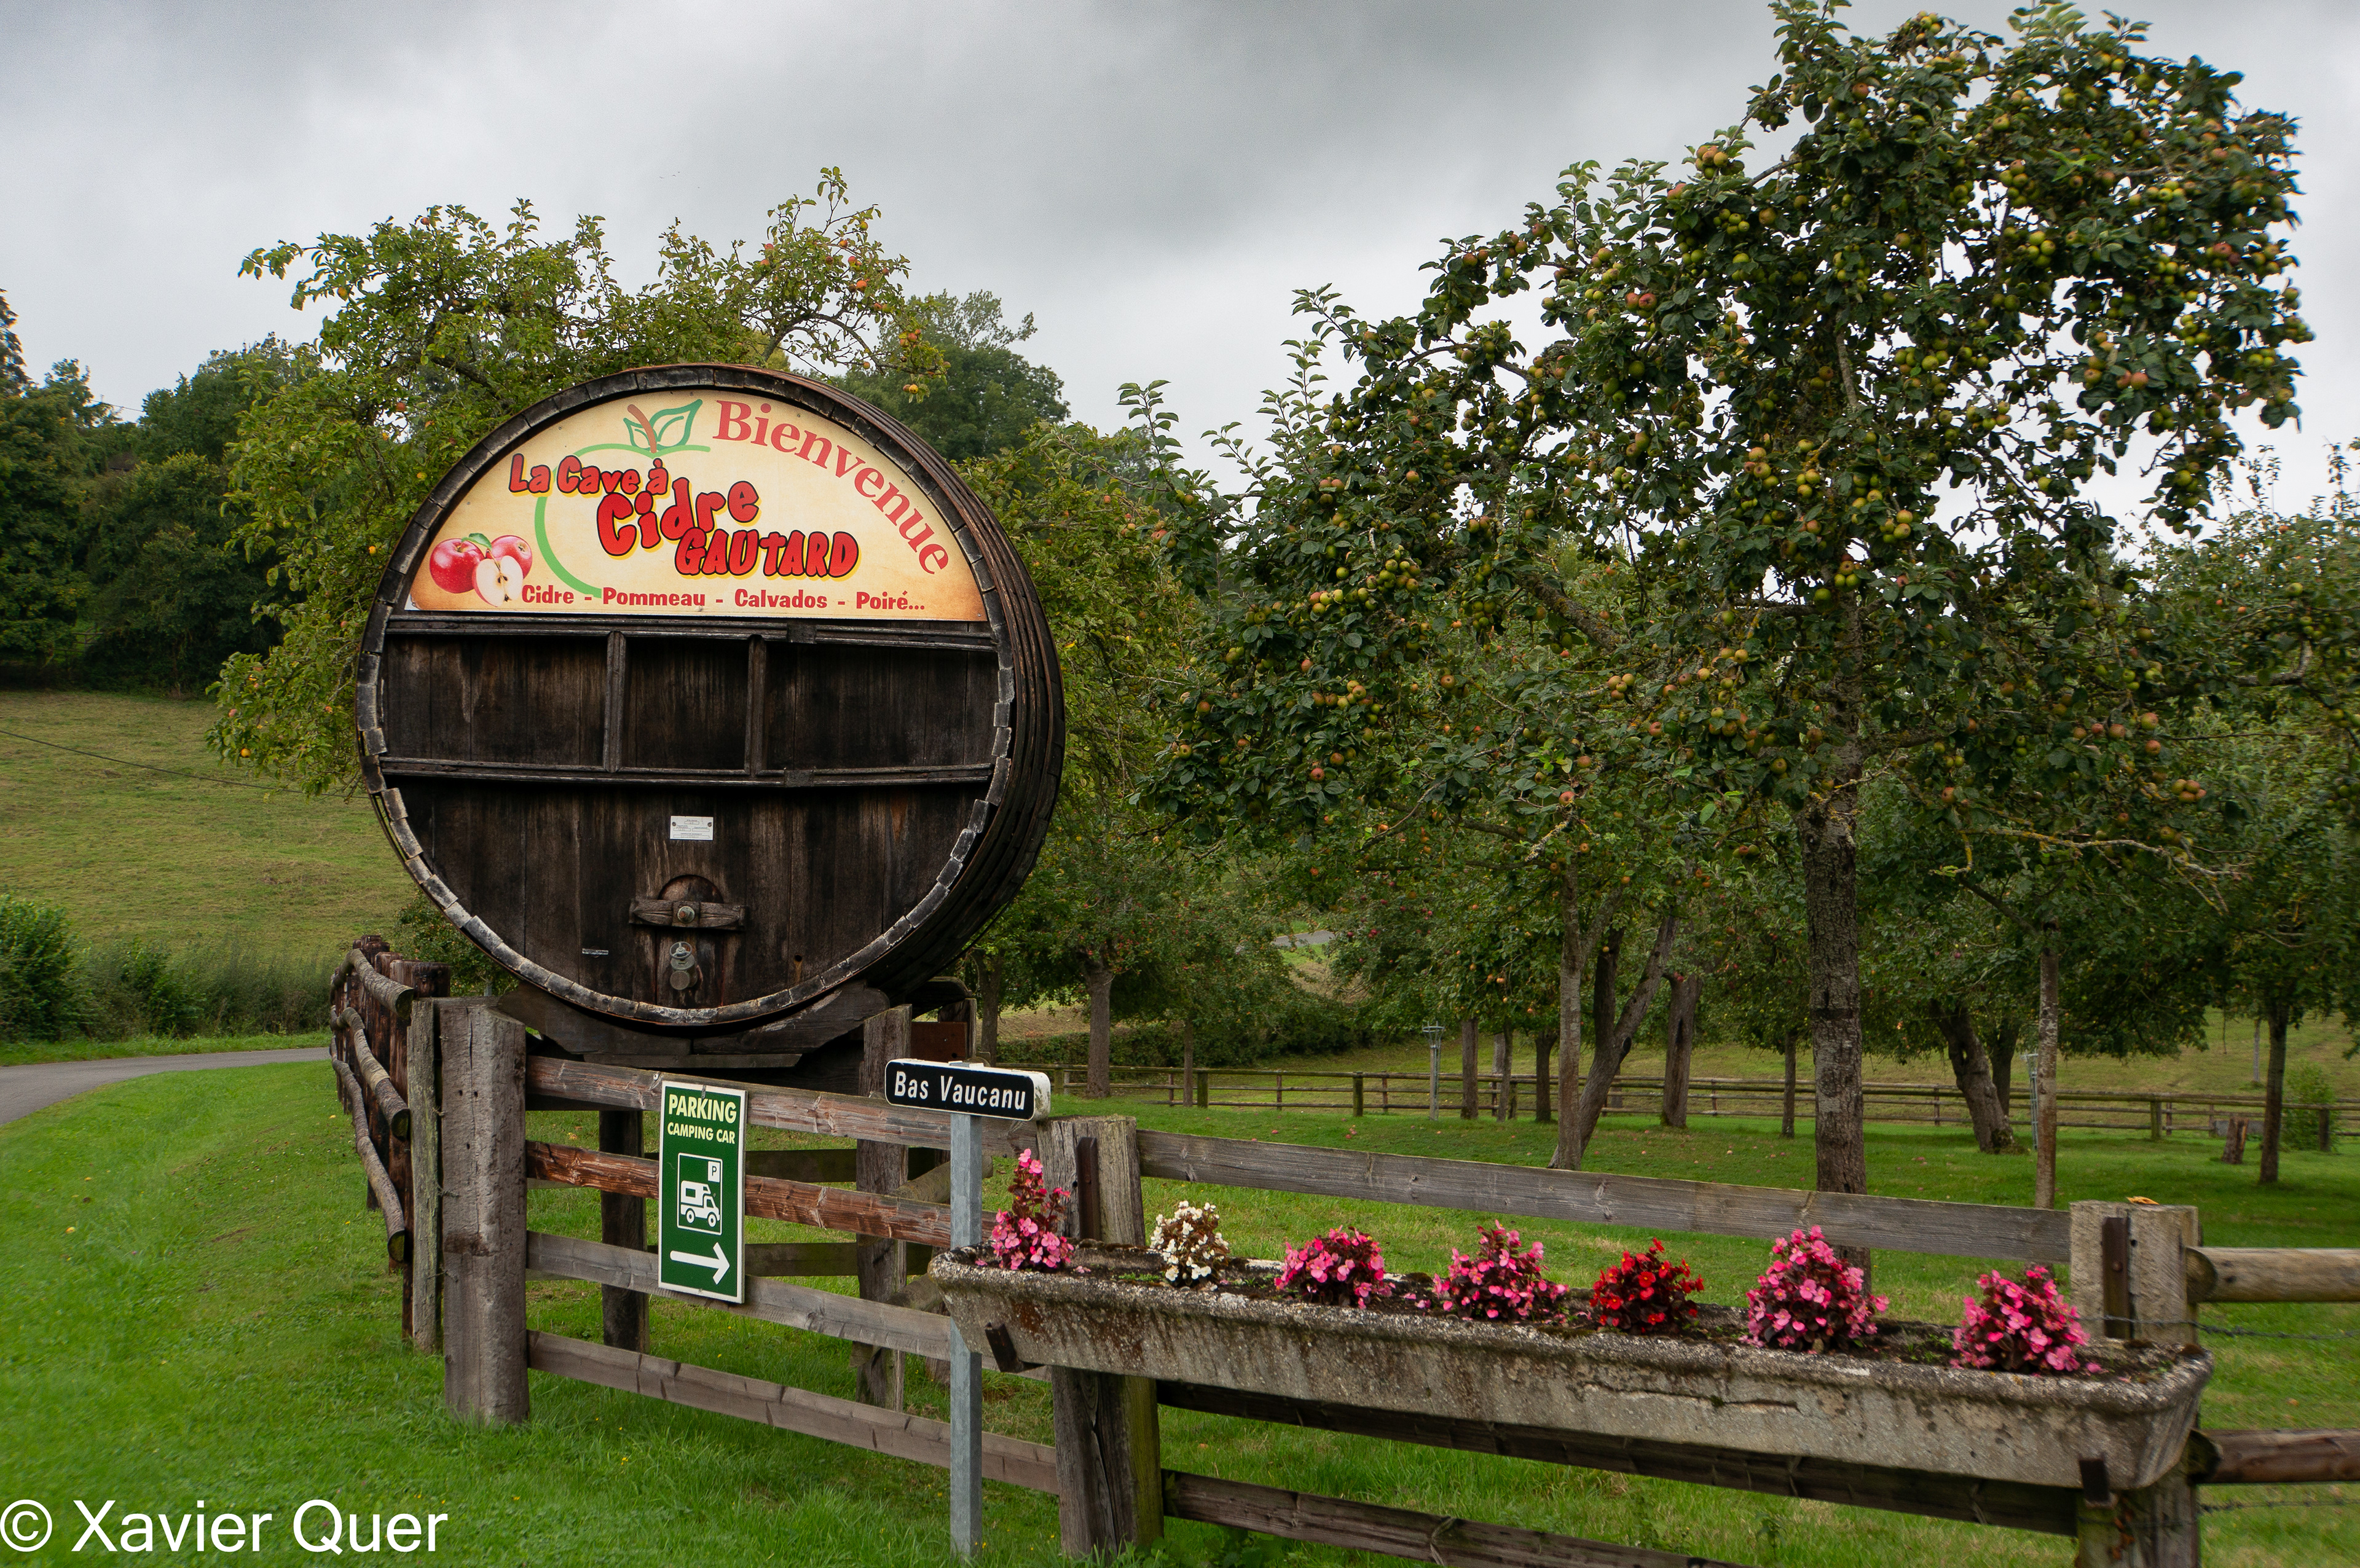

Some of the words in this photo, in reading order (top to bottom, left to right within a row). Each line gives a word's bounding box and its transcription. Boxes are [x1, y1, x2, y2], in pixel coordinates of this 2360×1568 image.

[509, 453, 552, 494] La
[556, 455, 642, 495] Cave
[712, 400, 950, 576] Bienvenue
[597, 477, 760, 557] Cidre
[675, 527, 860, 579] GAUTARD
[521, 584, 575, 605] Cidre
[602, 586, 706, 607] Pommeau
[734, 588, 828, 609] Calvados
[668, 1094, 737, 1124] PARKING
[894, 1070, 929, 1100] Bas
[940, 1075, 1026, 1111] Vaucanu
[667, 1122, 714, 1141] CAMPING
[716, 1129, 735, 1145] CAR
[712, 1166, 717, 1177] P
